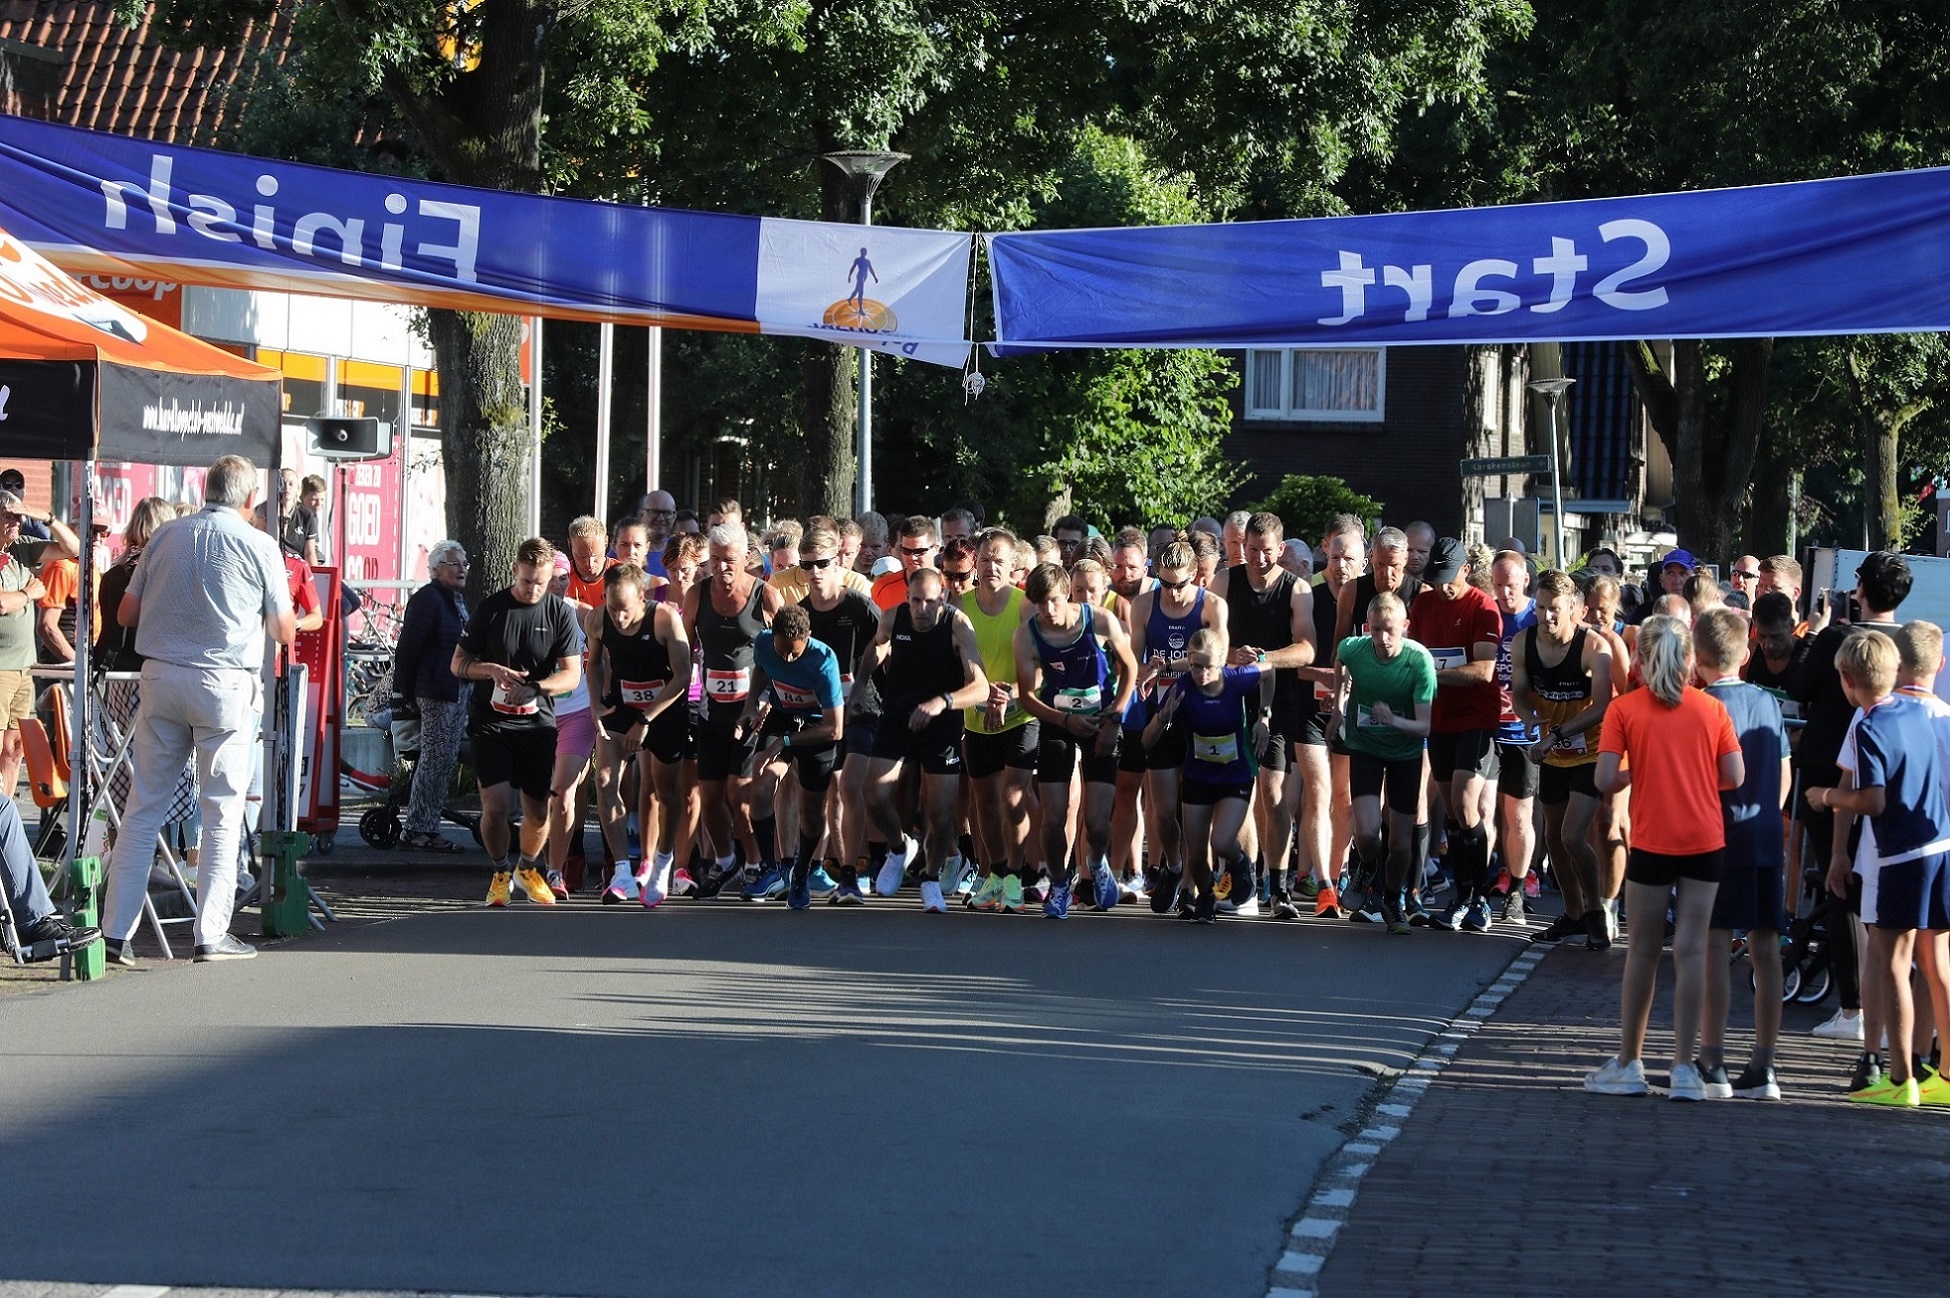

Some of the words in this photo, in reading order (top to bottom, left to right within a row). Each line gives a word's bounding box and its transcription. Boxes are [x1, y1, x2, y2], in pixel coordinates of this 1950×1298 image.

[347, 491, 380, 545] GOED
[716, 680, 738, 693] 21
[633, 690, 655, 702] 38
[1071, 697, 1082, 709] 2
[1209, 744, 1220, 756] 1
